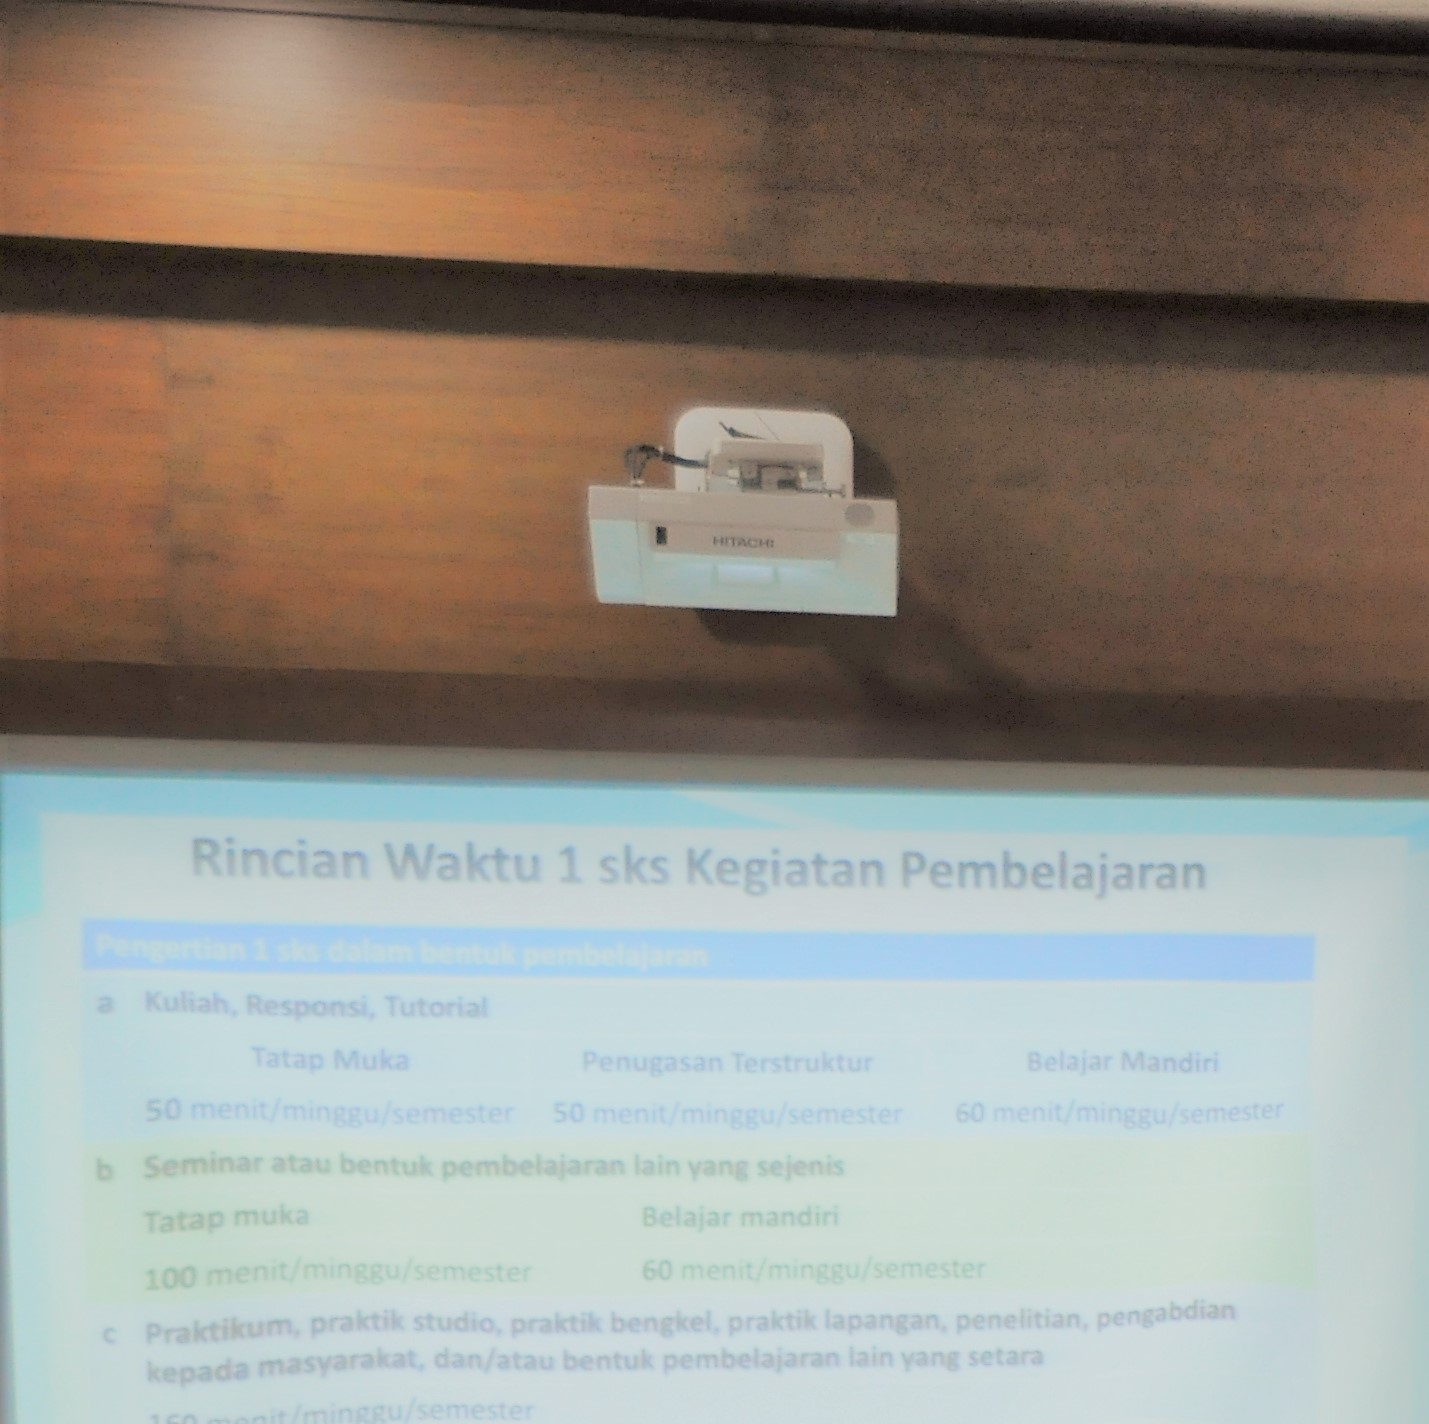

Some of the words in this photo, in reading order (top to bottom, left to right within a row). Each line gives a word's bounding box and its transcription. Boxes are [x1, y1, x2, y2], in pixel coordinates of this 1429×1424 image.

[713, 536, 775, 549] HITACHI
[191, 836, 369, 880] Rincian
[386, 841, 541, 883] Waktu
[559, 846, 580, 883] 1
[600, 845, 670, 885] sks
[686, 847, 886, 897] Kegiatan
[901, 850, 1206, 899] Pembelajaran
[97, 932, 245, 968] Pengertian
[254, 935, 268, 962] 1
[277, 937, 319, 964] sks
[328, 937, 412, 965] dalam
[420, 939, 514, 967] bentuk
[523, 941, 709, 974] pembelajaran
[97, 994, 114, 1015] a
[144, 991, 239, 1019] Kuliah,
[246, 993, 377, 1023] Responsi,
[385, 995, 489, 1020] Tutorial
[251, 1046, 324, 1074] Tatap
[334, 1049, 410, 1072] Muka
[582, 1050, 723, 1078] Penugasan
[730, 1050, 873, 1074] Terstruktur
[1027, 1050, 1113, 1076] Belajar
[1120, 1050, 1220, 1074] Mandiri
[145, 1098, 181, 1124] 50
[190, 1097, 515, 1128] menit/minggu/semester
[552, 1101, 585, 1125] 50
[592, 1100, 903, 1129] menit/minggu/semester
[955, 1101, 985, 1125] 60
[992, 1099, 1284, 1129] menit/minggu/semester
[97, 1157, 114, 1181] b
[144, 1151, 263, 1179] Seminar
[271, 1153, 331, 1175] atau
[339, 1153, 434, 1178] bentuk
[441, 1154, 625, 1181] pembelajaran
[634, 1155, 680, 1178] lain
[687, 1159, 749, 1182] yang
[757, 1155, 845, 1181] sejenis
[144, 1209, 224, 1235] Tatap
[233, 1205, 310, 1228] muka
[642, 1206, 731, 1233] Belajar
[740, 1206, 839, 1229] mandiri
[145, 1266, 198, 1291] 100
[206, 1258, 532, 1288] menit/minggu/semester
[642, 1259, 673, 1283] 60
[680, 1256, 986, 1287] menit/minggu/semester
[103, 1326, 117, 1345] c
[145, 1315, 302, 1345] Praktikum,
[310, 1311, 405, 1339] praktik
[413, 1311, 502, 1338] studio,
[510, 1311, 602, 1338] praktik
[610, 1312, 720, 1339] bengkel,
[728, 1310, 817, 1335] praktik
[824, 1307, 948, 1335] lapangan,
[956, 1306, 1089, 1335] penelitian,
[1097, 1299, 1237, 1332] pengabdian
[145, 1360, 250, 1389] kepada
[258, 1349, 427, 1379] masyarakat,
[433, 1347, 554, 1374] dan/atau
[563, 1347, 654, 1373] bentuk
[662, 1345, 840, 1374] pembelajaran
[848, 1345, 893, 1369] lain
[901, 1349, 960, 1374] yang
[967, 1346, 1044, 1369] setara
